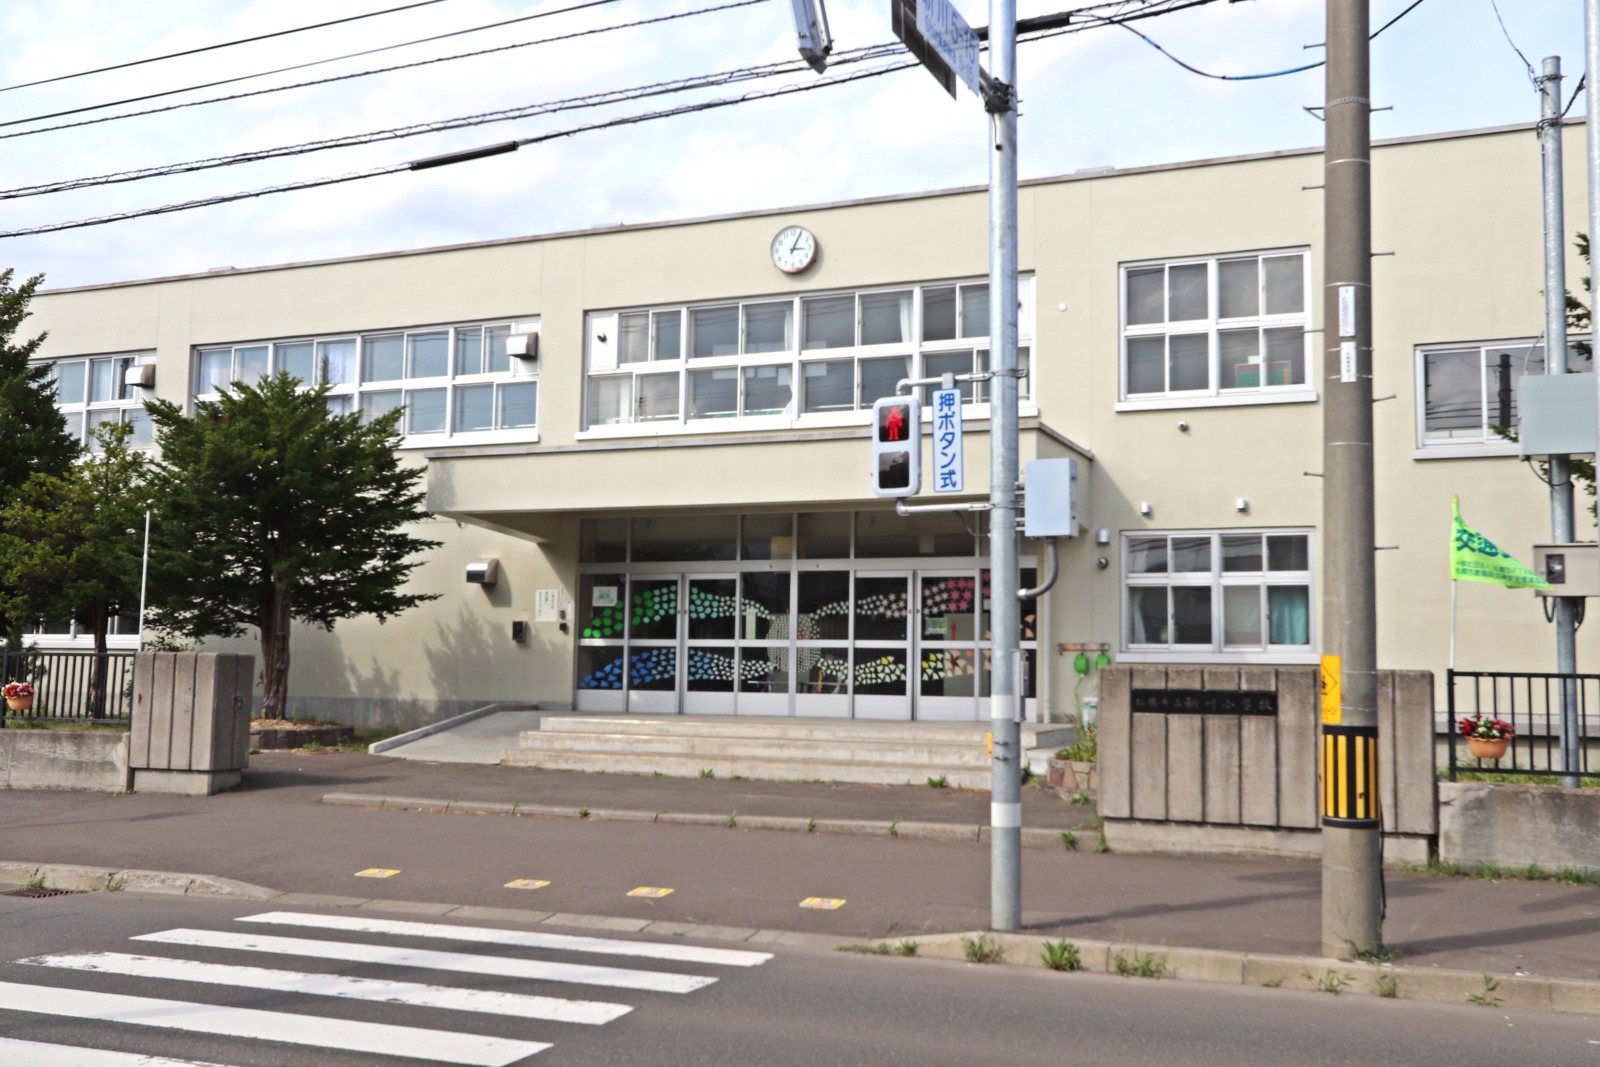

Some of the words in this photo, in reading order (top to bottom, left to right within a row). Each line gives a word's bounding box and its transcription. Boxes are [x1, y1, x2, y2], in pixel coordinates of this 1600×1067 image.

[938, 392, 957, 488] 押ボタン式
